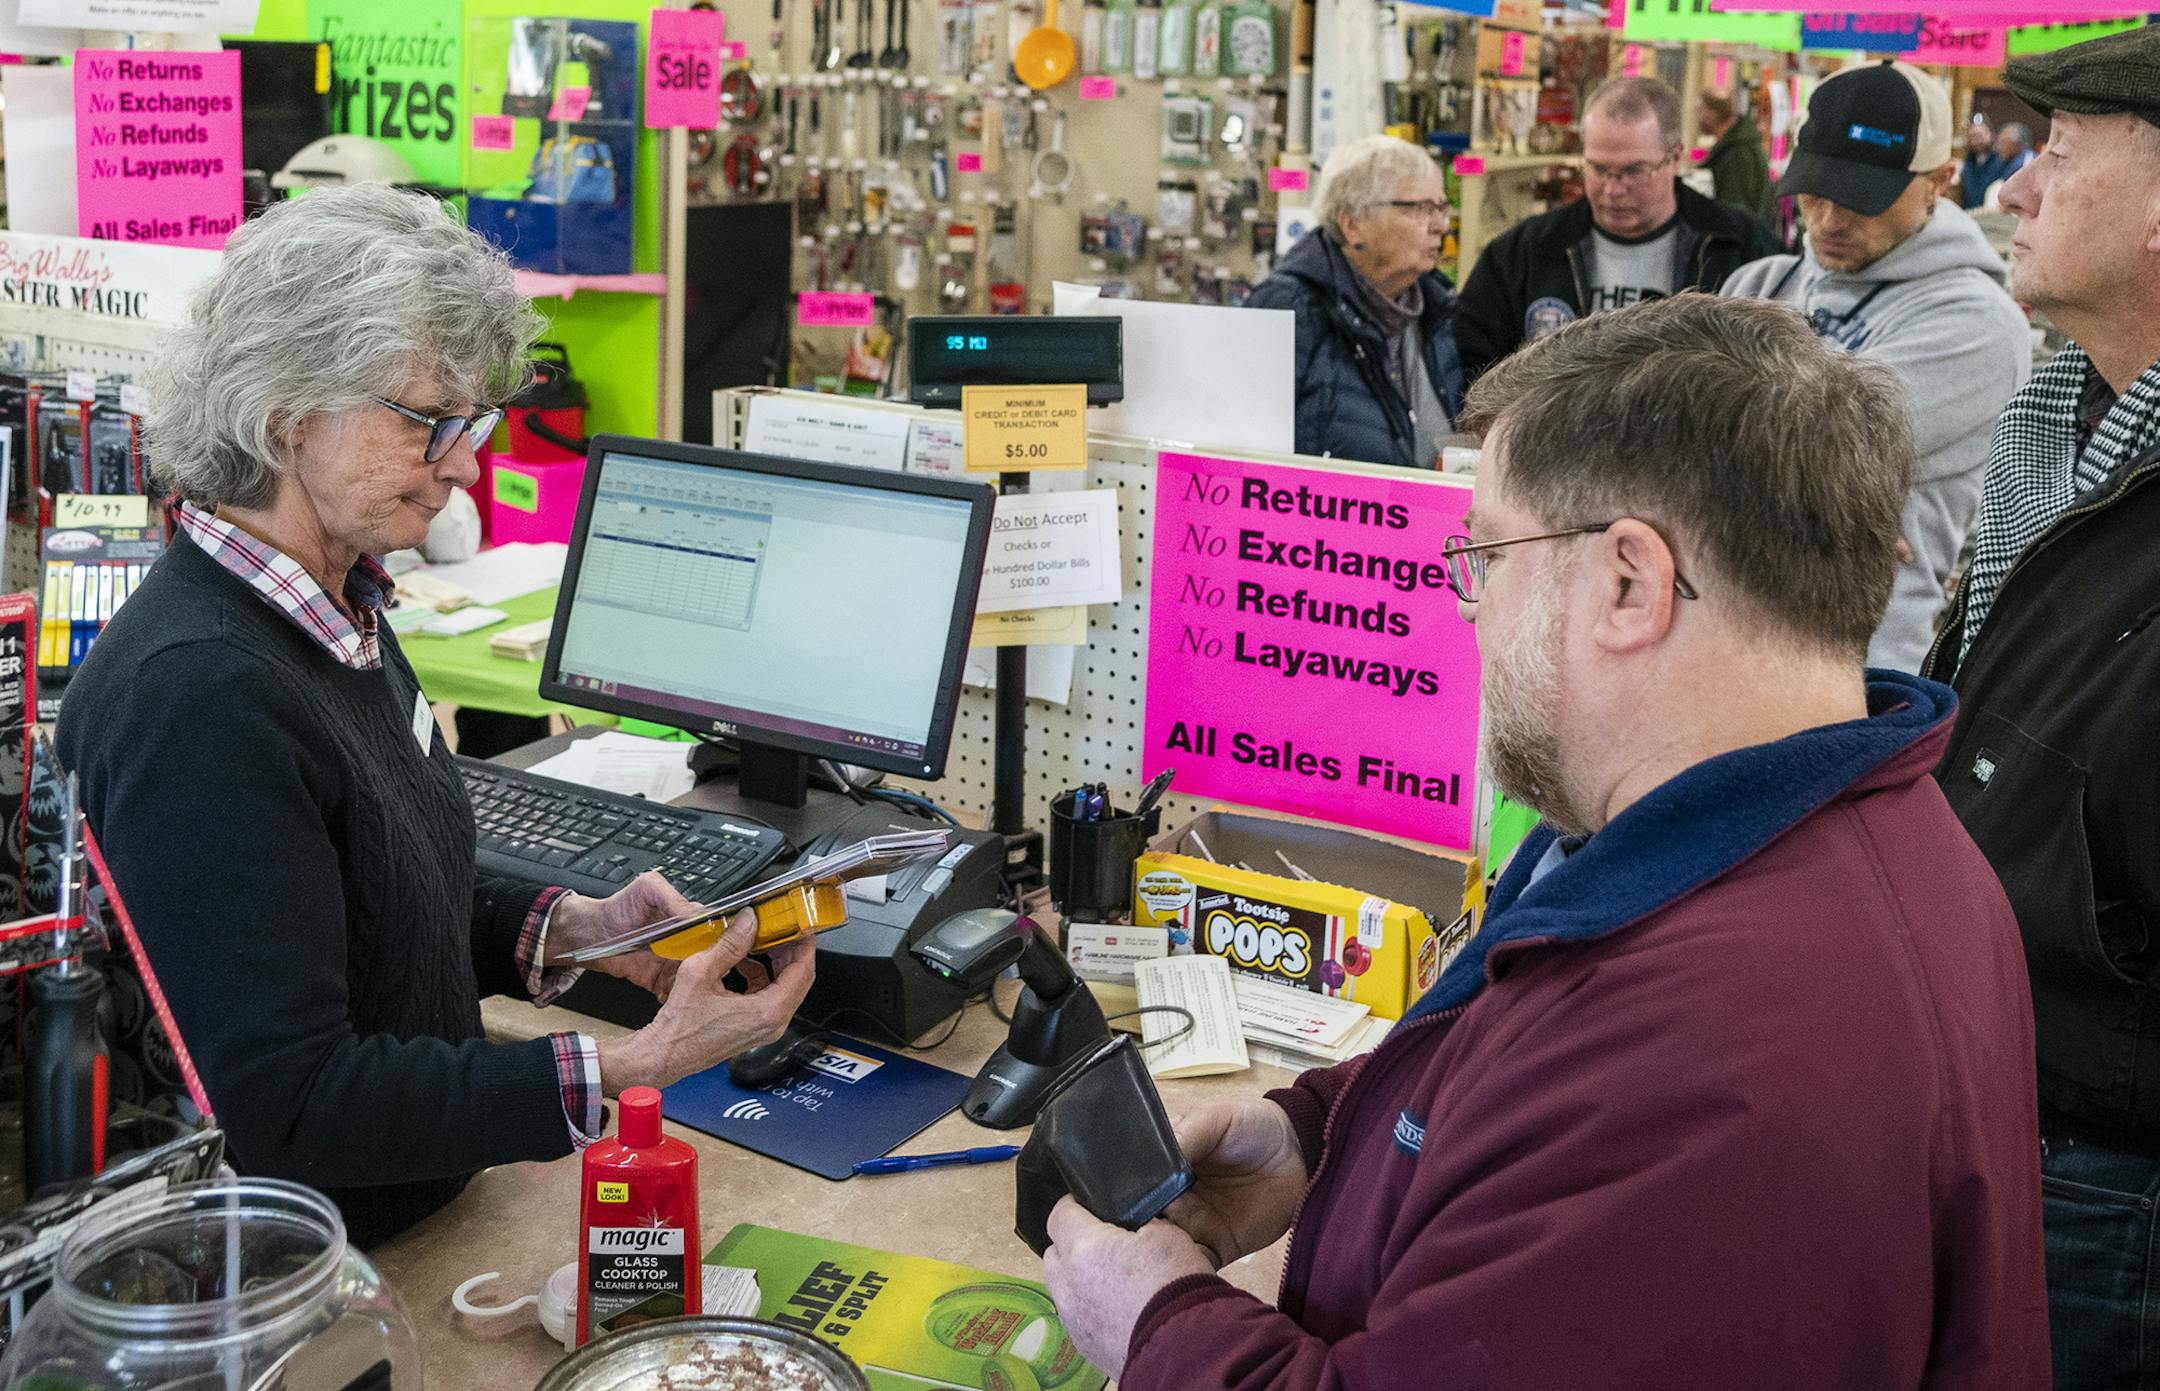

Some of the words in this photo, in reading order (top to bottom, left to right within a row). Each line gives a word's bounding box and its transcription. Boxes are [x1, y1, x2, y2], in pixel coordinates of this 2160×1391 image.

[88, 60, 114, 80] No
[118, 60, 204, 81] Returns
[658, 54, 711, 90] Sale
[89, 94, 115, 113] No
[120, 92, 233, 116] Exchanges
[91, 127, 116, 146] No
[122, 124, 208, 145] Refunds
[92, 159, 117, 178] No
[123, 157, 224, 179] Layaways
[92, 222, 118, 240] All
[126, 219, 183, 240] Sales
[189, 214, 237, 236] Final
[71, 286, 149, 320] MAGIC
[946, 335, 965, 350] 95
[1006, 400, 1045, 408] MINIMUM
[975, 410, 1008, 419] CREDIT
[1022, 410, 1048, 418] DEBIT
[1052, 409, 1077, 418] CARD
[994, 420, 1059, 429] TRANSACTION
[1006, 443, 1048, 458] $5.00
[1181, 472, 1229, 506] No
[1241, 476, 1409, 529] Returns
[994, 517, 1010, 530] Do
[1014, 515, 1038, 528] Not
[1042, 512, 1088, 527] Accept
[1004, 540, 1038, 552] Checks
[1040, 541, 1052, 549] or
[1181, 523, 1227, 557] No
[993, 562, 1034, 575] Hundred
[1037, 560, 1067, 571] Dollar
[1070, 557, 1090, 568] Bills
[1009, 576, 1050, 590] $100.00
[1180, 574, 1225, 608] No
[1237, 581, 1411, 637] Refunds
[1011, 615, 1035, 623] Checks
[1178, 625, 1223, 659] No
[1235, 633, 1439, 697] Layaways
[713, 720, 737, 735] DELL
[1165, 721, 1216, 758] All
[1231, 731, 1342, 782] Sales
[1357, 755, 1461, 806] Final
[1233, 896, 1291, 924] Tootsie
[1209, 915, 1306, 973] POPS
[772, 1088, 787, 1099] to
[795, 1080, 835, 1099] with
[792, 1093, 823, 1113] Tap
[600, 1230, 670, 1250] magic
[614, 1257, 658, 1267] GLASS
[601, 1269, 668, 1280] COOKTOP
[595, 1281, 636, 1289] CLEANER
[646, 1282, 678, 1290] POLISH
[836, 1271, 890, 1321] SPLIT
[823, 1322, 852, 1337] &
